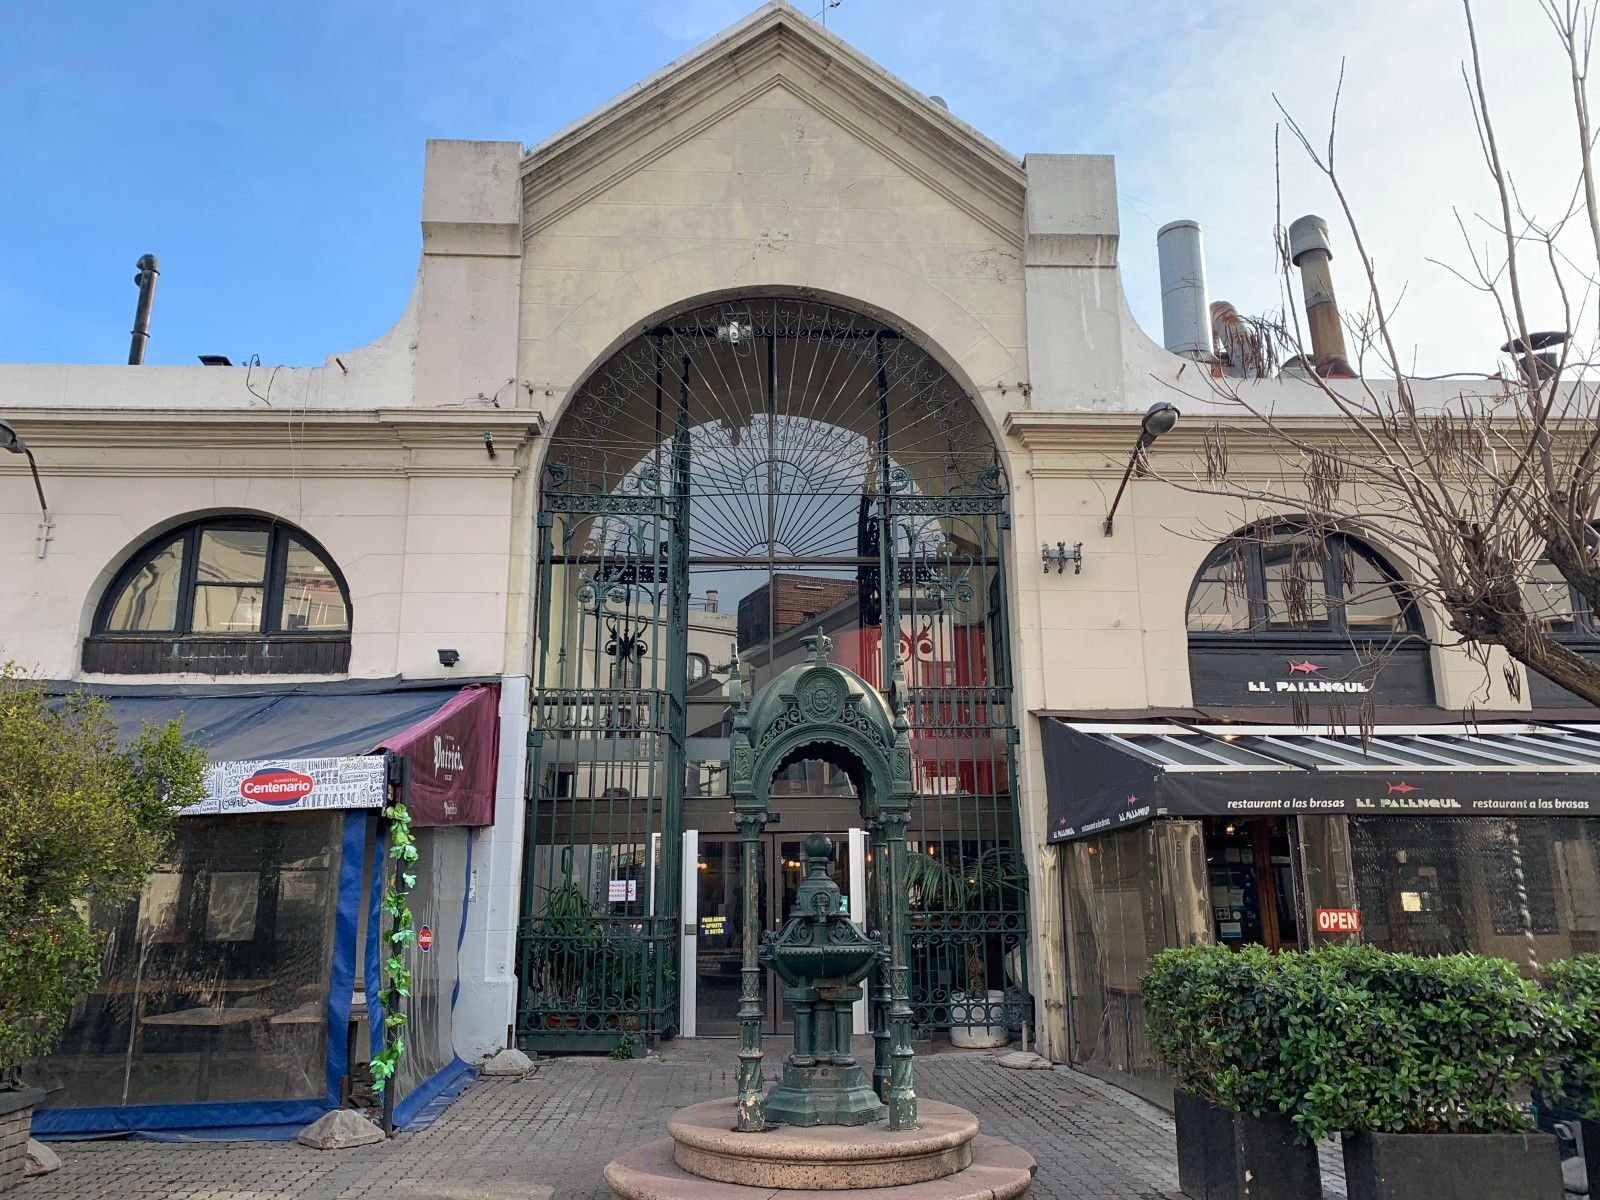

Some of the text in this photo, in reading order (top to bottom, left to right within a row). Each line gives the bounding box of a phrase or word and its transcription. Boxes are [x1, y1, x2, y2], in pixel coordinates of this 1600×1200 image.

[1247, 681, 1369, 693] EL PALENQUE
[243, 781, 311, 794] Centenario
[1227, 799, 1281, 808] restaurant
[1292, 798, 1307, 808] las
[1309, 798, 1345, 808] brasas
[1356, 798, 1461, 808] EL PALENQUE
[1472, 799, 1527, 808] restaurant
[1538, 798, 1553, 809] las
[1554, 799, 1590, 809] brasas
[1319, 911, 1358, 929] OPEN
